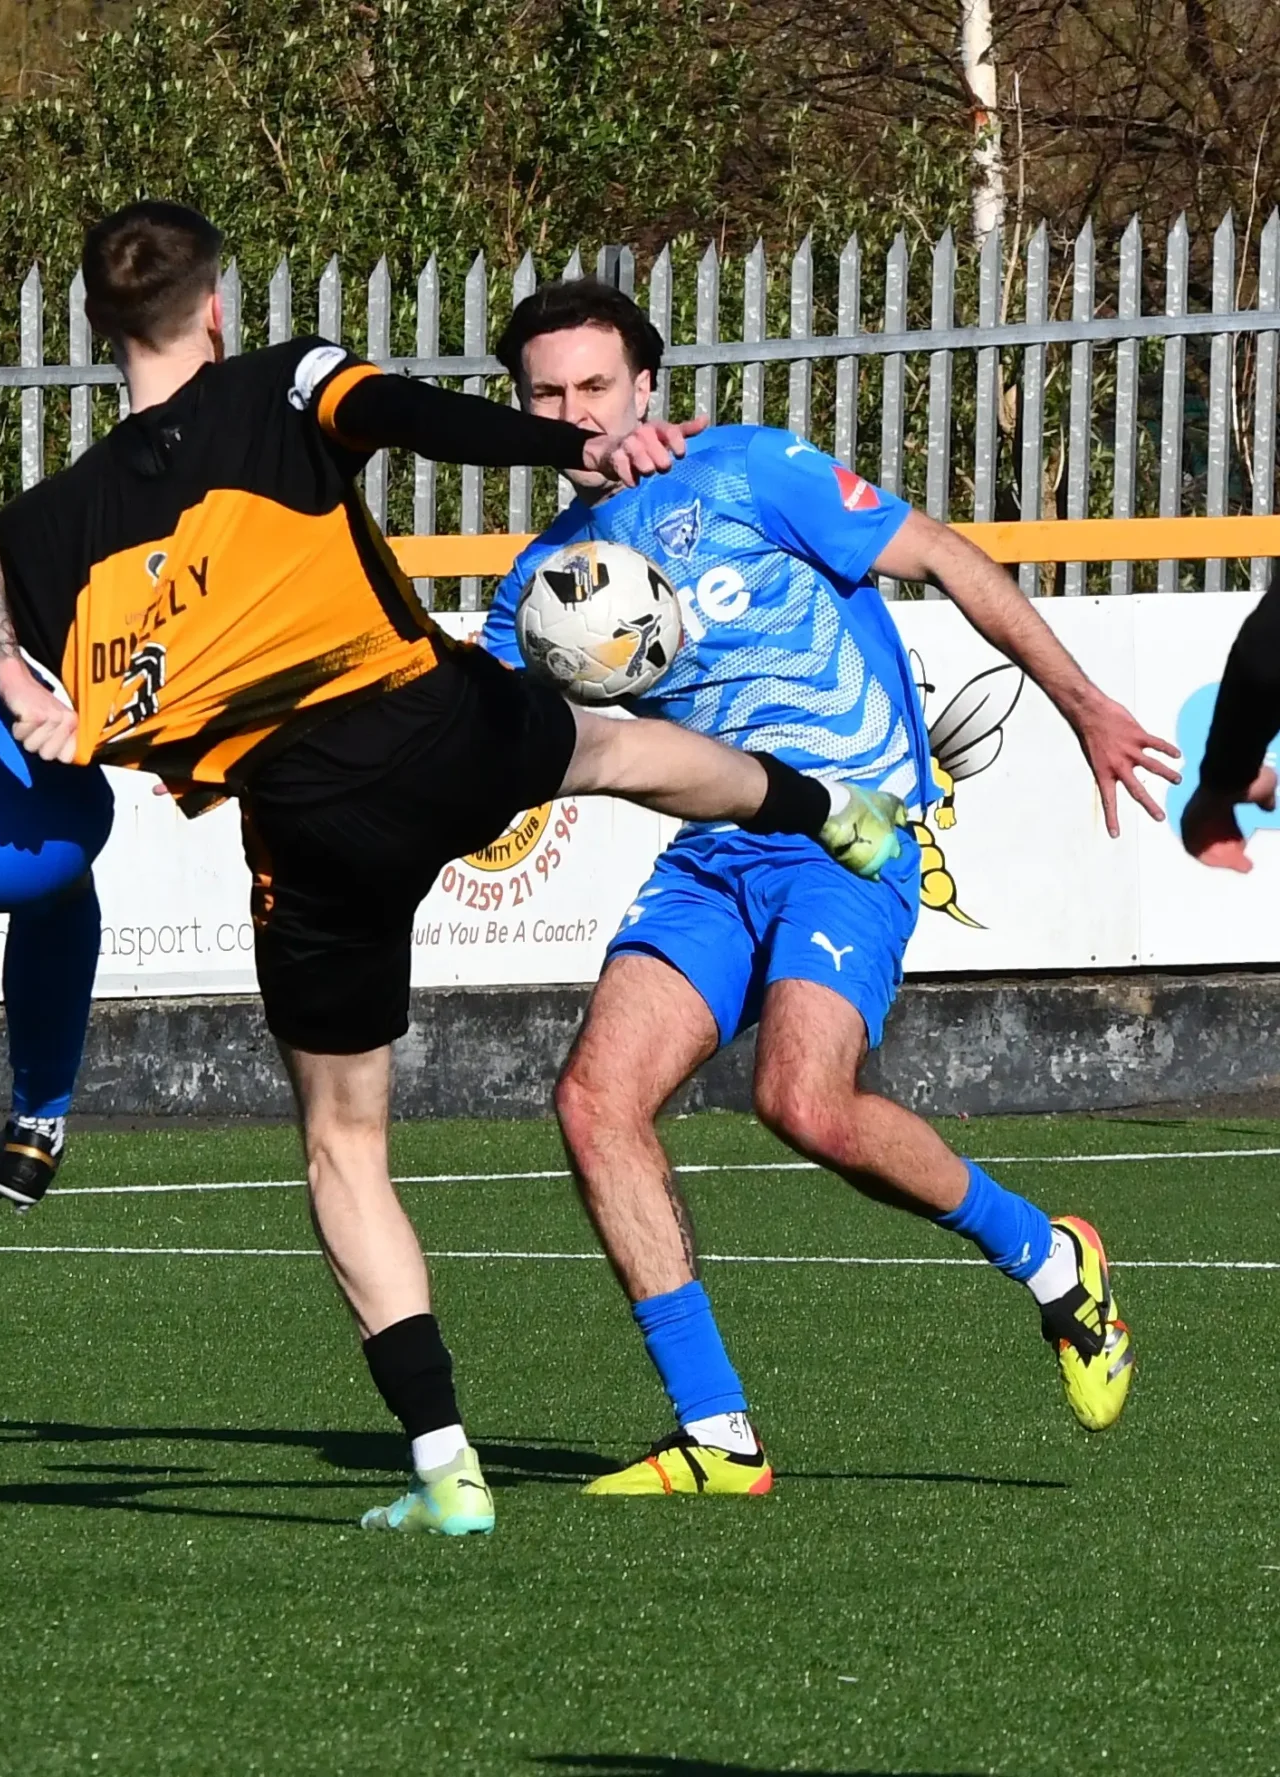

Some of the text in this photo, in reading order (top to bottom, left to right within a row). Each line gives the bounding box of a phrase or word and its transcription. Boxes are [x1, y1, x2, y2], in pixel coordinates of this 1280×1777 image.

[514, 816, 540, 852] CLUB
[441, 801, 578, 912] 01259 21 95 96
[448, 921, 480, 946] You
[485, 921, 508, 944] Be
[512, 920, 526, 943] A
[532, 918, 598, 943] Coach?
